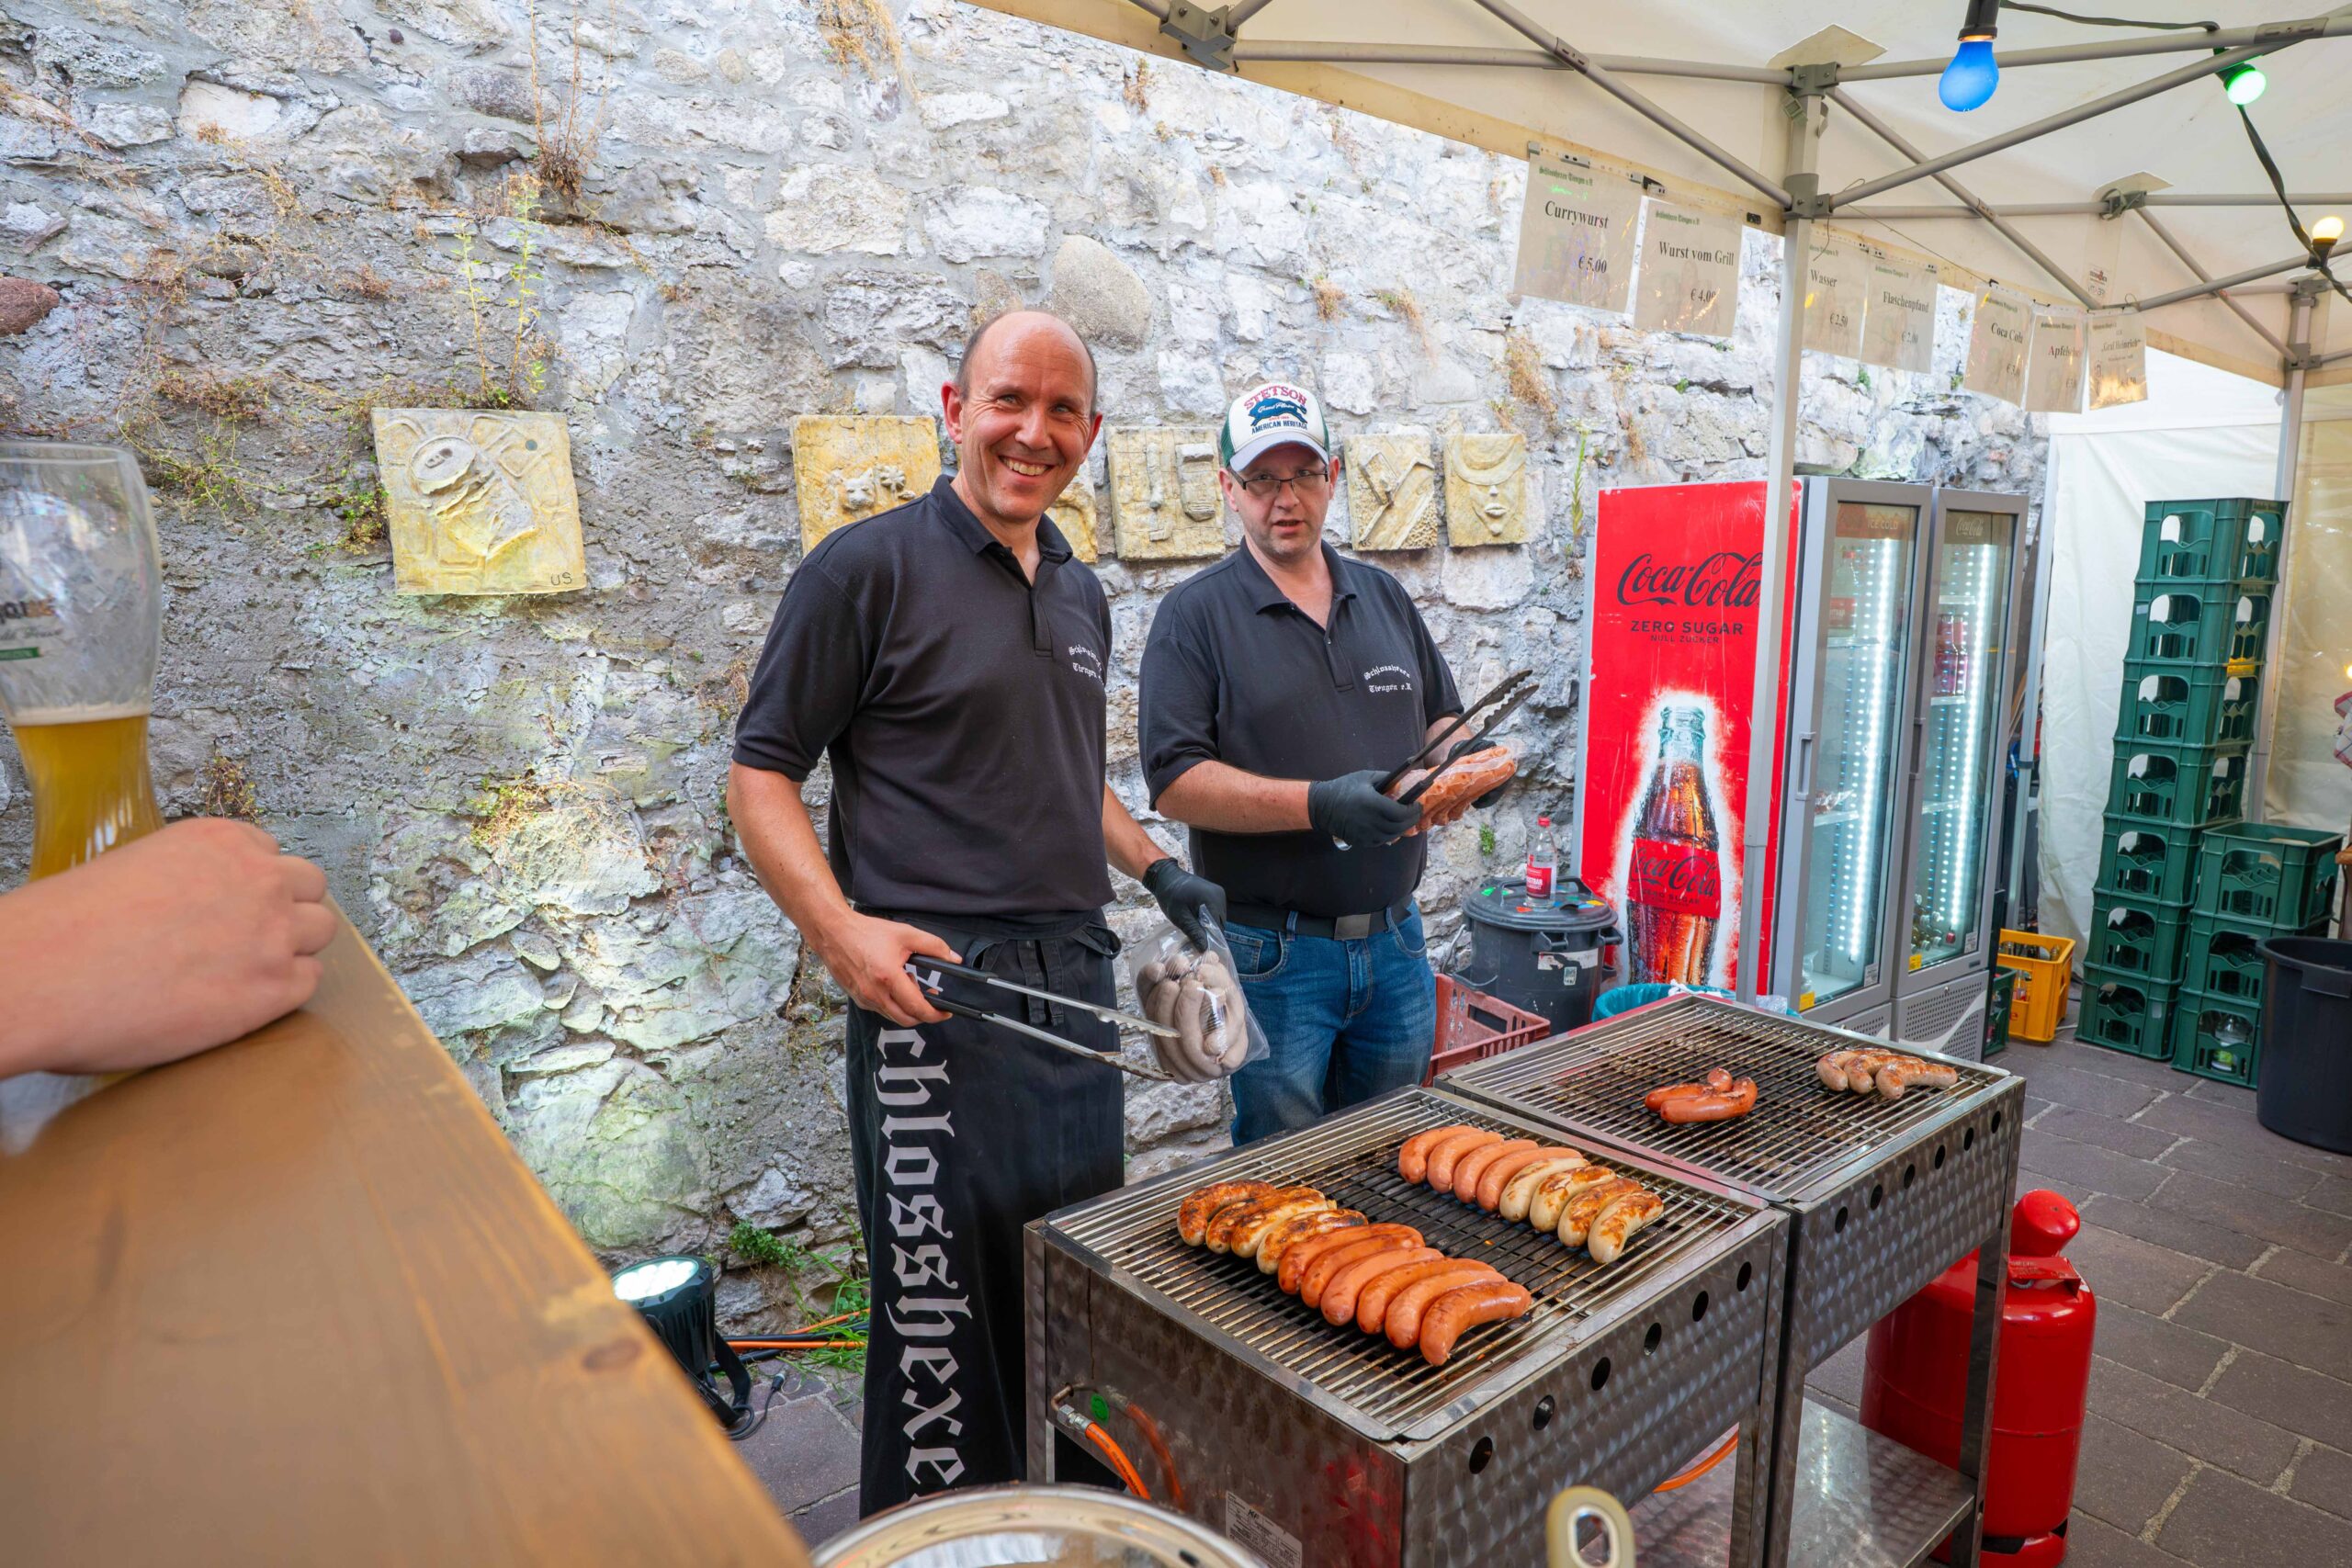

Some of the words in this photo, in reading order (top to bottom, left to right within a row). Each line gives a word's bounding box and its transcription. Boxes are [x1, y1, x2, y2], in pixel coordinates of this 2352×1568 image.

[1544, 199, 1609, 229] Currywurst
[1659, 241, 1689, 259] Wurst
[1691, 249, 1713, 263] vom
[1714, 250, 1735, 265] Grill
[1587, 256, 1608, 274] 5,00
[1810, 269, 1838, 288] Wasser
[1883, 290, 1929, 312] Flaschenpfand
[1991, 321, 2007, 339] Coca
[1244, 385, 1307, 411] STETSON
[1251, 421, 1282, 434] AMERICAN
[1283, 420, 1308, 431] HERITAGE
[1881, 520, 1899, 530] COLD
[550, 571, 573, 586] US
[1617, 551, 1763, 608] Coca-Cola
[1631, 620, 1675, 633] ZERO
[1682, 621, 1744, 636] SUGAR
[1650, 635, 1675, 643] NULL
[1679, 636, 1720, 644] ZUCKER
